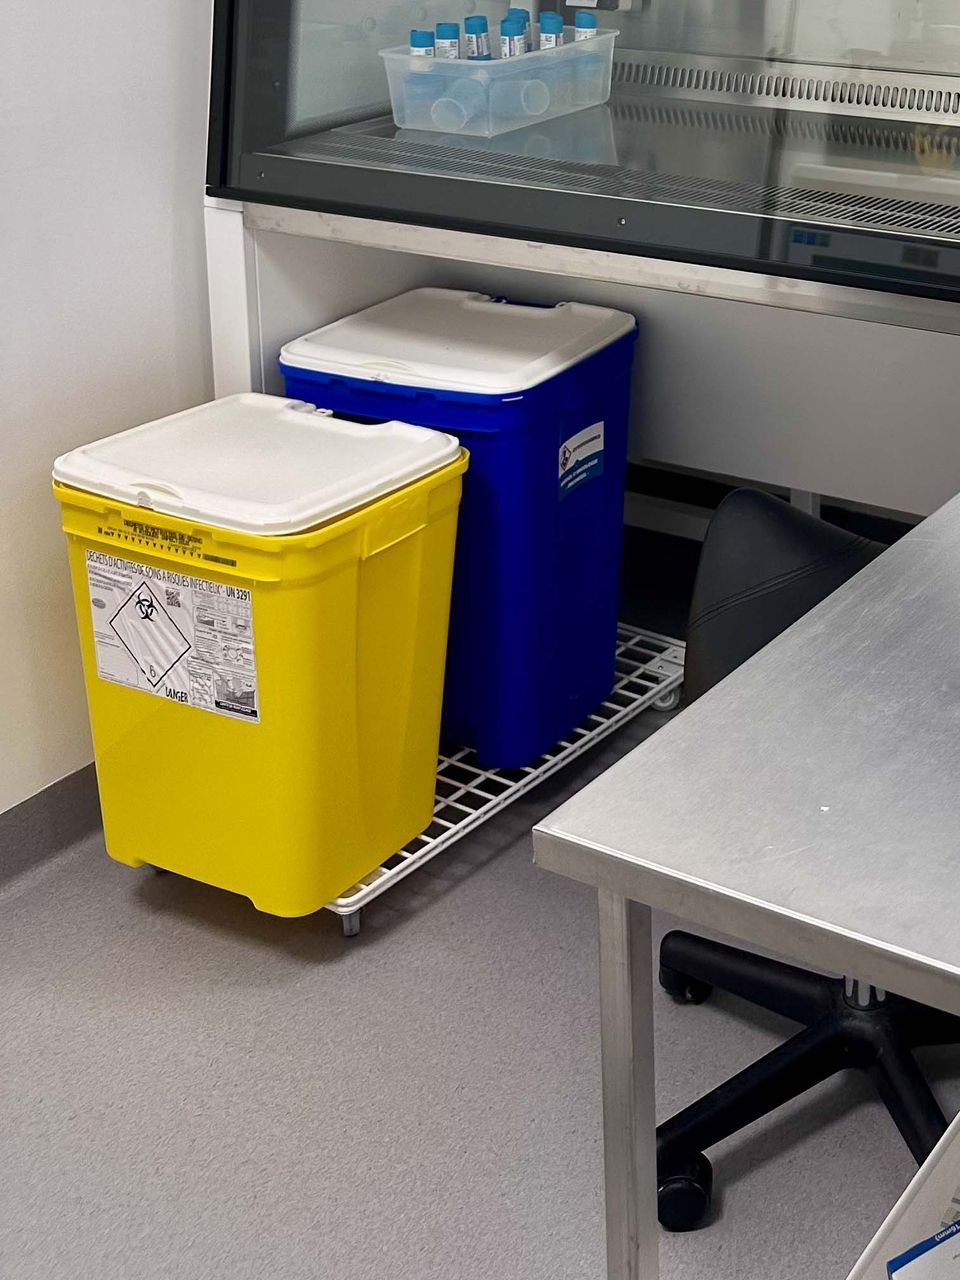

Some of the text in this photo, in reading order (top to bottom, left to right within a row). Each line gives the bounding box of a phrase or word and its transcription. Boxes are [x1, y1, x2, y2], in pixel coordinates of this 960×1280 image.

[226, 586, 236, 598] UN
[236, 588, 251, 602] 3291
[149, 664, 156, 678] 6
[934, 1220, 960, 1242] 16mm)
